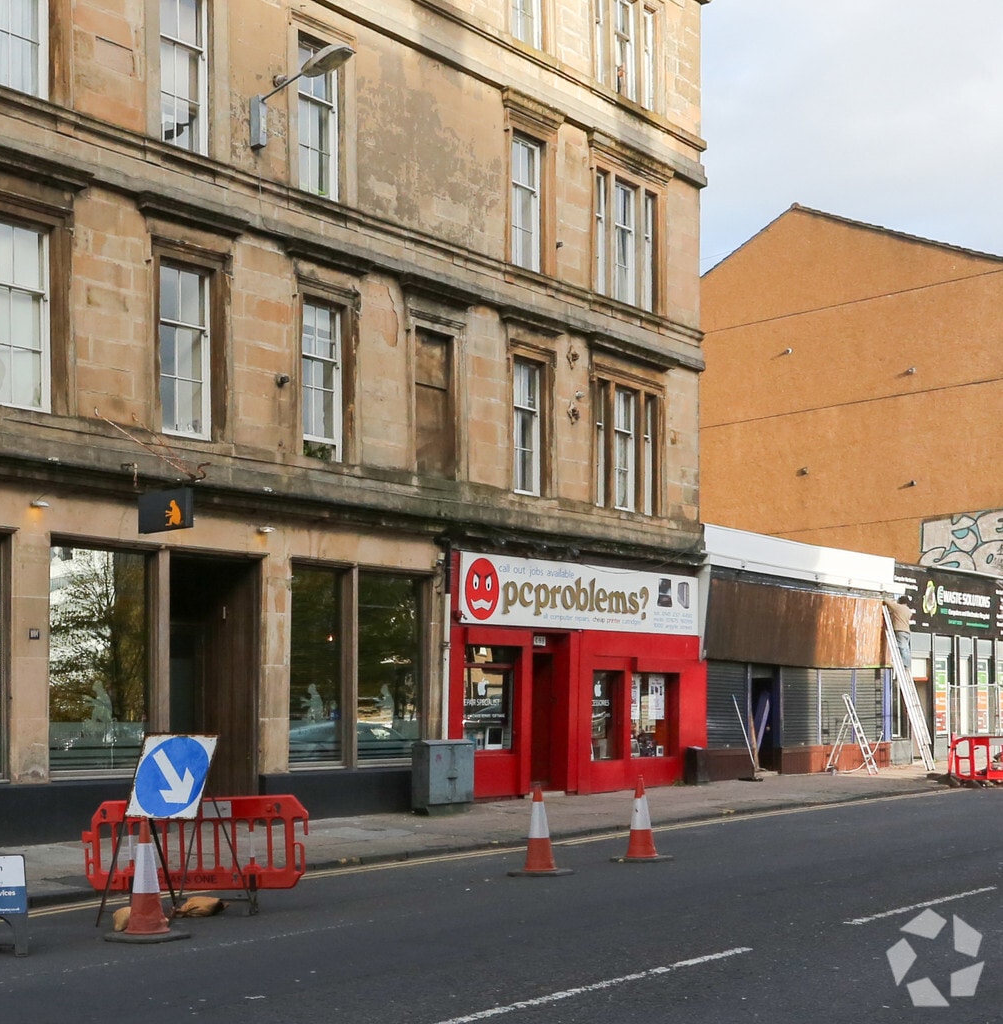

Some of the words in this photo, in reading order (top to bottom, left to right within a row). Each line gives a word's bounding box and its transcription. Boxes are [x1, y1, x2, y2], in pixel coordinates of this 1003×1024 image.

[498, 563, 511, 573] call
[513, 566, 526, 575] out
[529, 566, 544, 577] jobs
[546, 568, 575, 579] available
[194, 875, 218, 884] ONE
